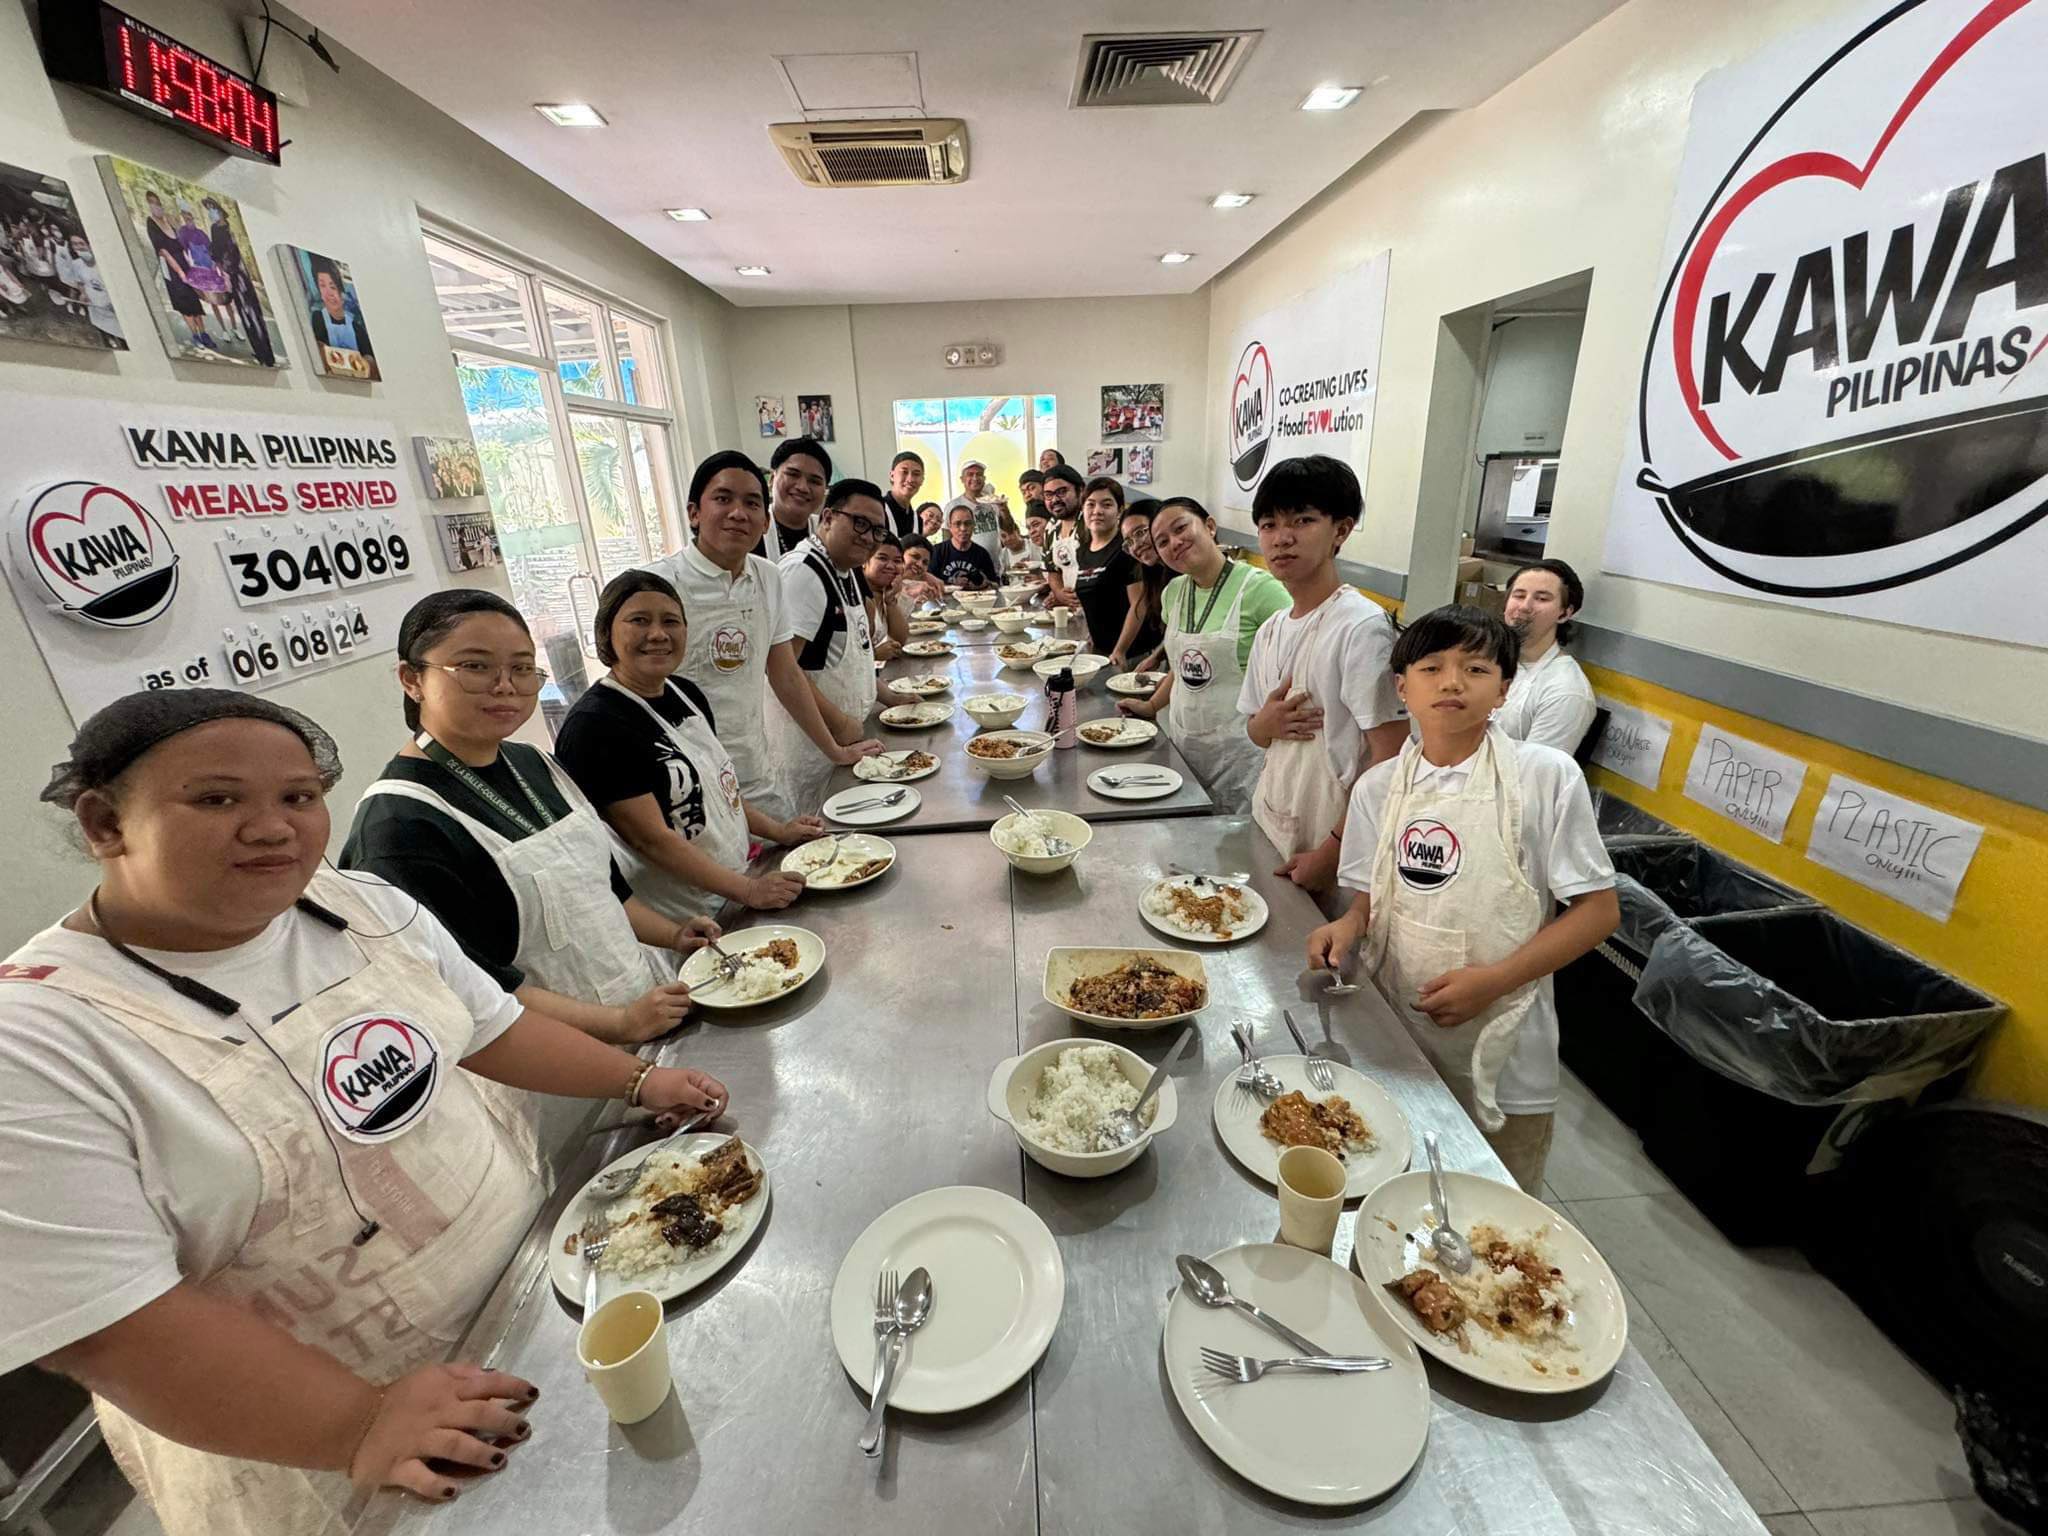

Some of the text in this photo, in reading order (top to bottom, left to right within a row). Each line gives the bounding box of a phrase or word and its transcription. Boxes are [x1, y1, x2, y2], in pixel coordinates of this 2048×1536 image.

[1701, 152, 2048, 406] KAWA
[1279, 368, 1368, 407] CO-CREATING LIVES
[1826, 325, 2032, 418] PILIPINAS
[1236, 388, 1263, 440] KAWA
[128, 428, 397, 465] KAWA PILIPINAS
[165, 480, 397, 517] MEALS SERVED
[52, 524, 147, 581] KAWA
[112, 557, 152, 581] PILIPINAS
[229, 534, 410, 597] 304089
[943, 560, 977, 577] CONVER
[146, 613, 369, 690] as of 06 08 24
[455, 766, 465, 777] LA
[1703, 738, 1782, 815] PAPER
[1408, 841, 1445, 864] KAWA
[1828, 790, 1961, 879] PLASTIC
[340, 1044, 412, 1105] KAWA
